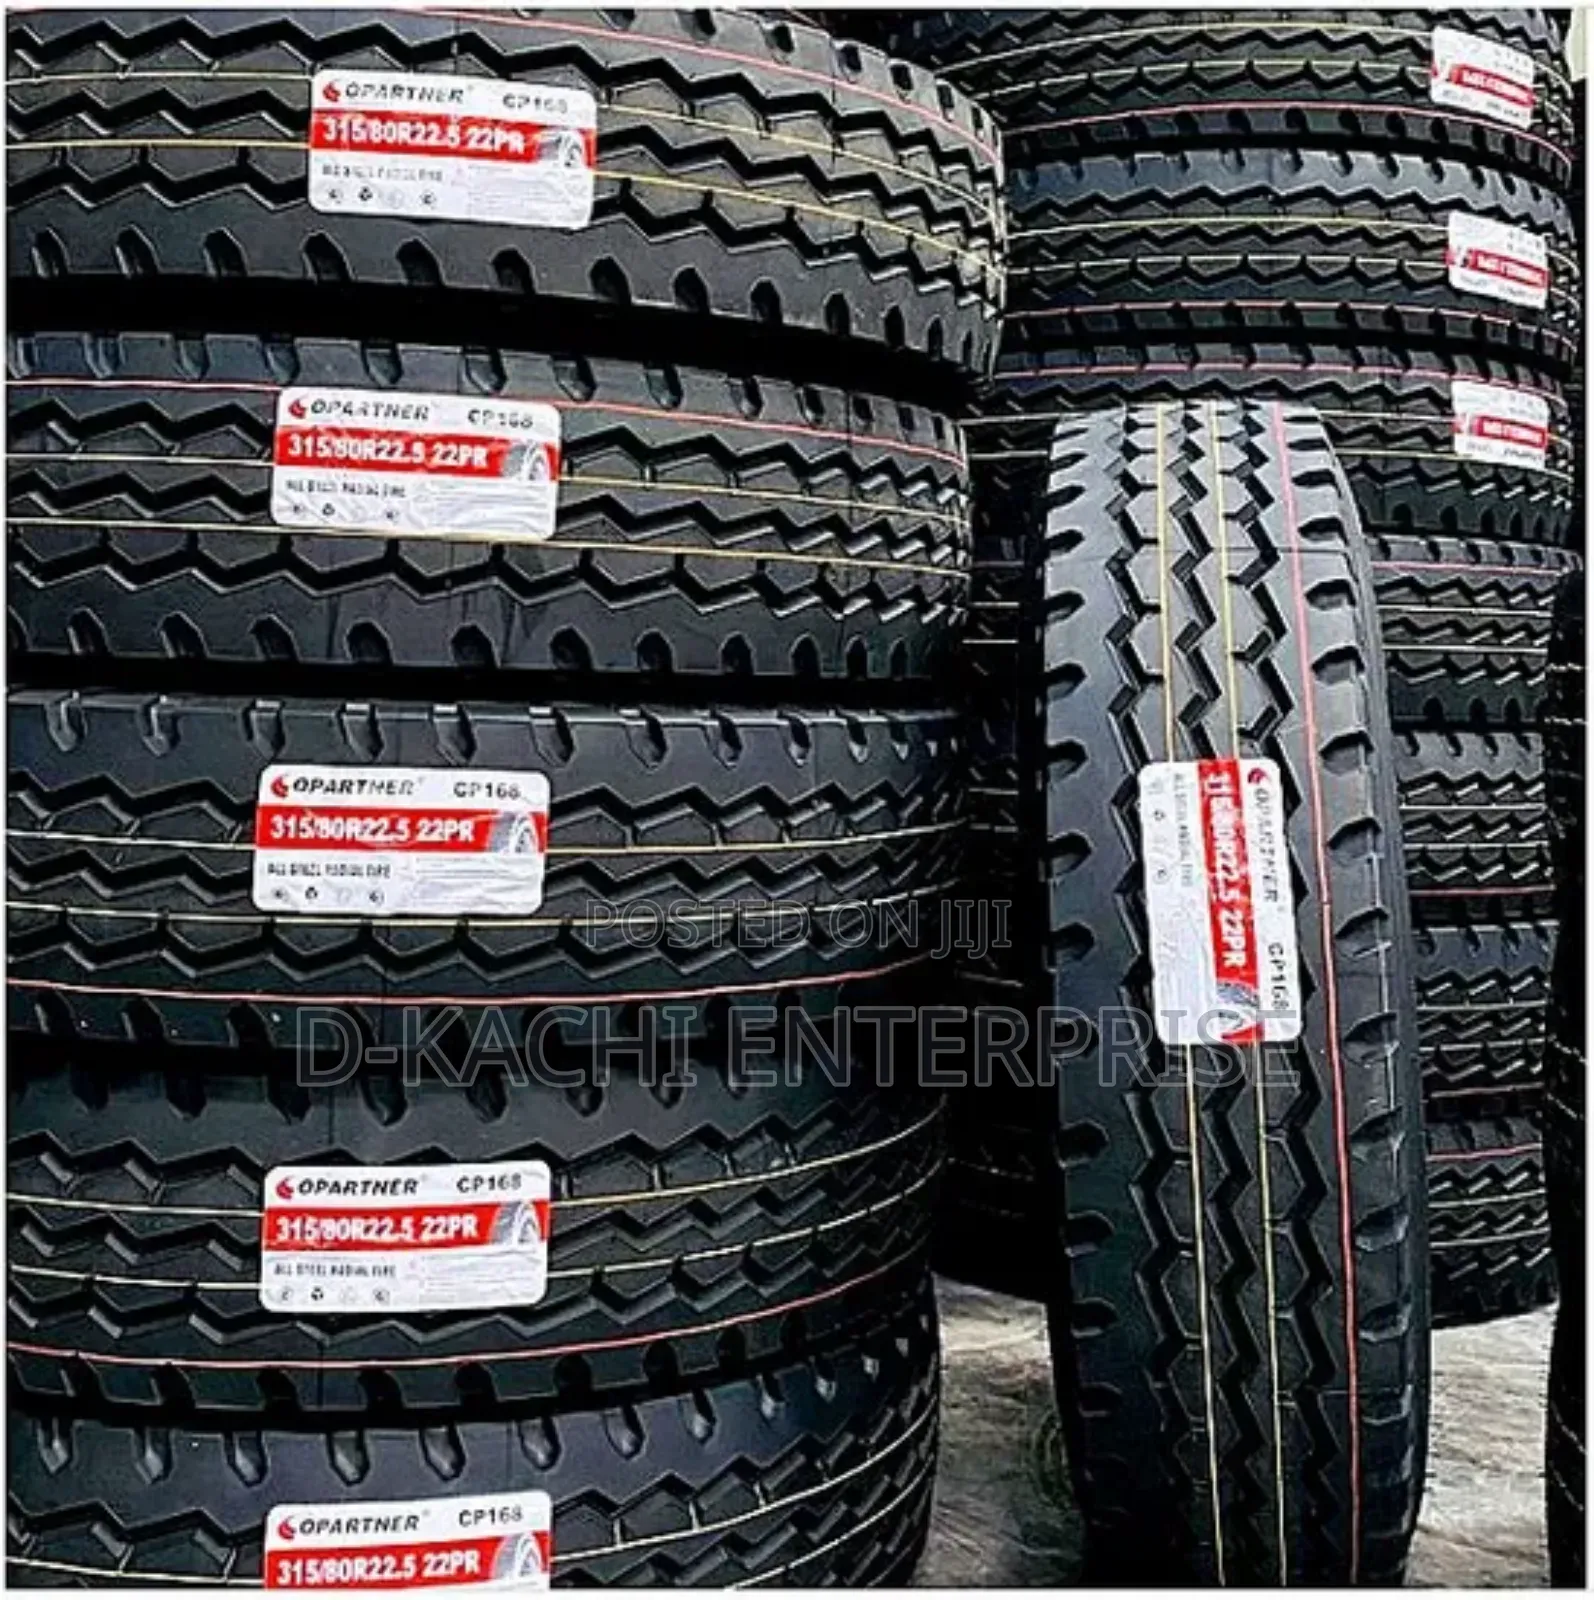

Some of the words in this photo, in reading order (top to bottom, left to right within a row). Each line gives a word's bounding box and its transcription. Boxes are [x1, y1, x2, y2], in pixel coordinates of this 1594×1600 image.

[467, 128, 525, 154] 22PR
[432, 444, 490, 468] 22PR
[416, 819, 475, 843] 22PR
[1218, 907, 1247, 968] 22PR
[420, 1214, 478, 1241] 22PR
[458, 1505, 523, 1528] CP168
[422, 1549, 479, 1577] 22PR
